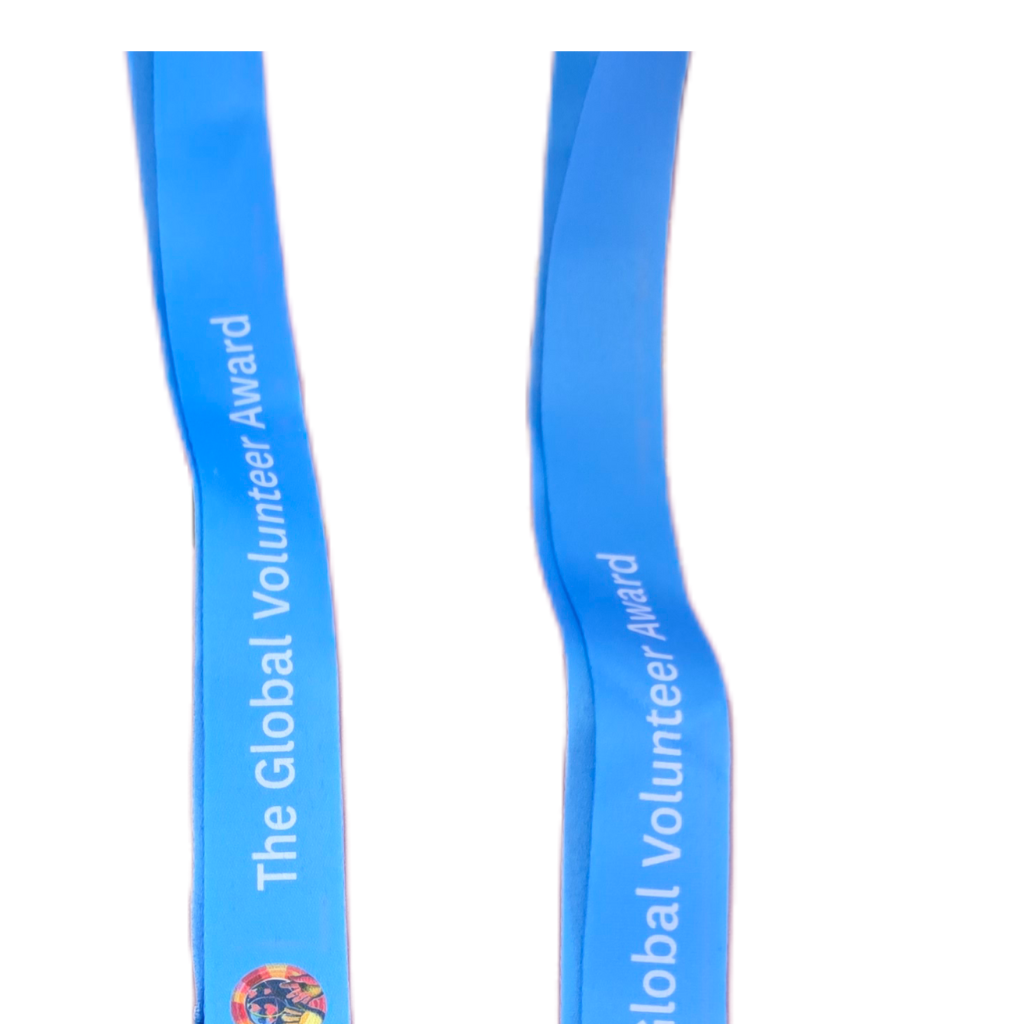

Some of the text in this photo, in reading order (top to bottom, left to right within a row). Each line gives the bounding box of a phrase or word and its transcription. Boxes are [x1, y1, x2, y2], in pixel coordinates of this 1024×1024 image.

[209, 315, 297, 891] The Global Volunteer Award
[596, 553, 667, 641] Award
[639, 645, 683, 868] Volunteer
